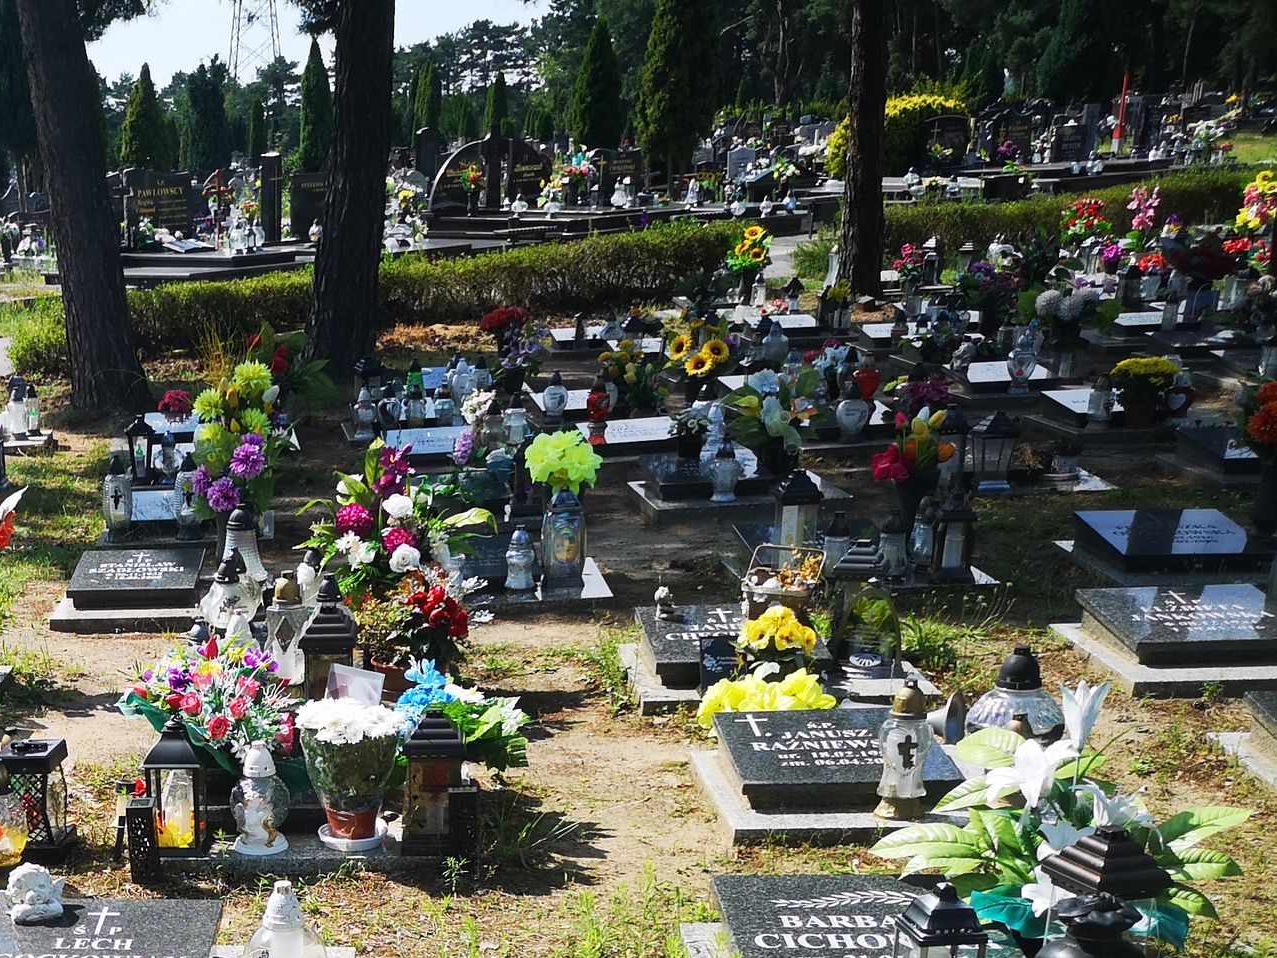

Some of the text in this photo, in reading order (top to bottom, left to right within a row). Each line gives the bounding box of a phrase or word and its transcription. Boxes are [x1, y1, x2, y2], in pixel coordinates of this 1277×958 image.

[781, 729, 873, 740] JANUSZ
[750, 738, 880, 751] RAŹNIEWS
[814, 759, 885, 767] 06.04.20
[777, 914, 896, 928] BARBA
[109, 926, 123, 935] P
[52, 937, 134, 950] LECH
